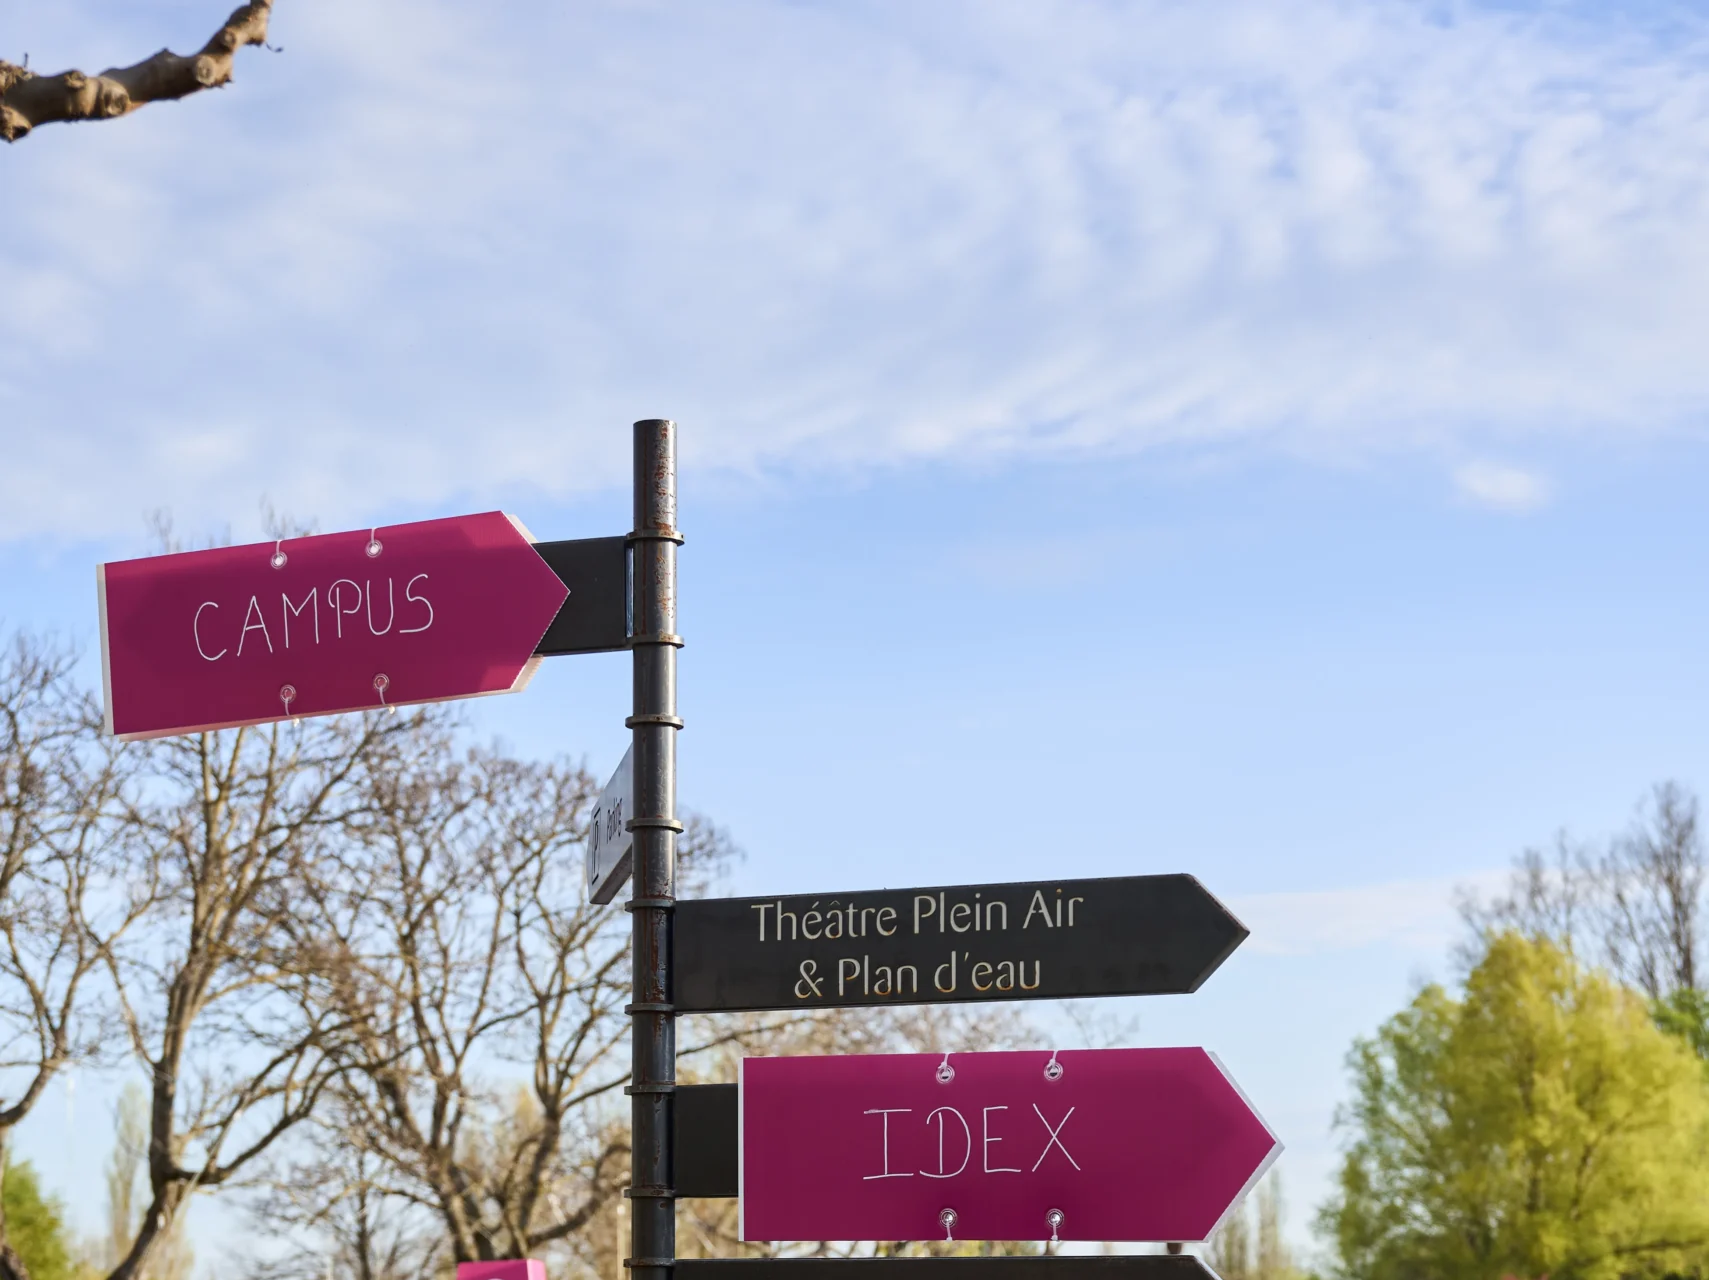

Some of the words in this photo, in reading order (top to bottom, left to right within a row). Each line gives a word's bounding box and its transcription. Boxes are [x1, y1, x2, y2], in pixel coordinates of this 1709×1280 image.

[193, 573, 434, 661] CAMPUS
[606, 797, 623, 845] Parking
[751, 901, 897, 942] Théâtre
[913, 891, 1008, 934] Plein
[1022, 888, 1084, 929] Air
[794, 959, 824, 999] &
[838, 954, 918, 996] Plan
[934, 951, 1041, 993] d'eau
[863, 1103, 1081, 1180] IDEX
